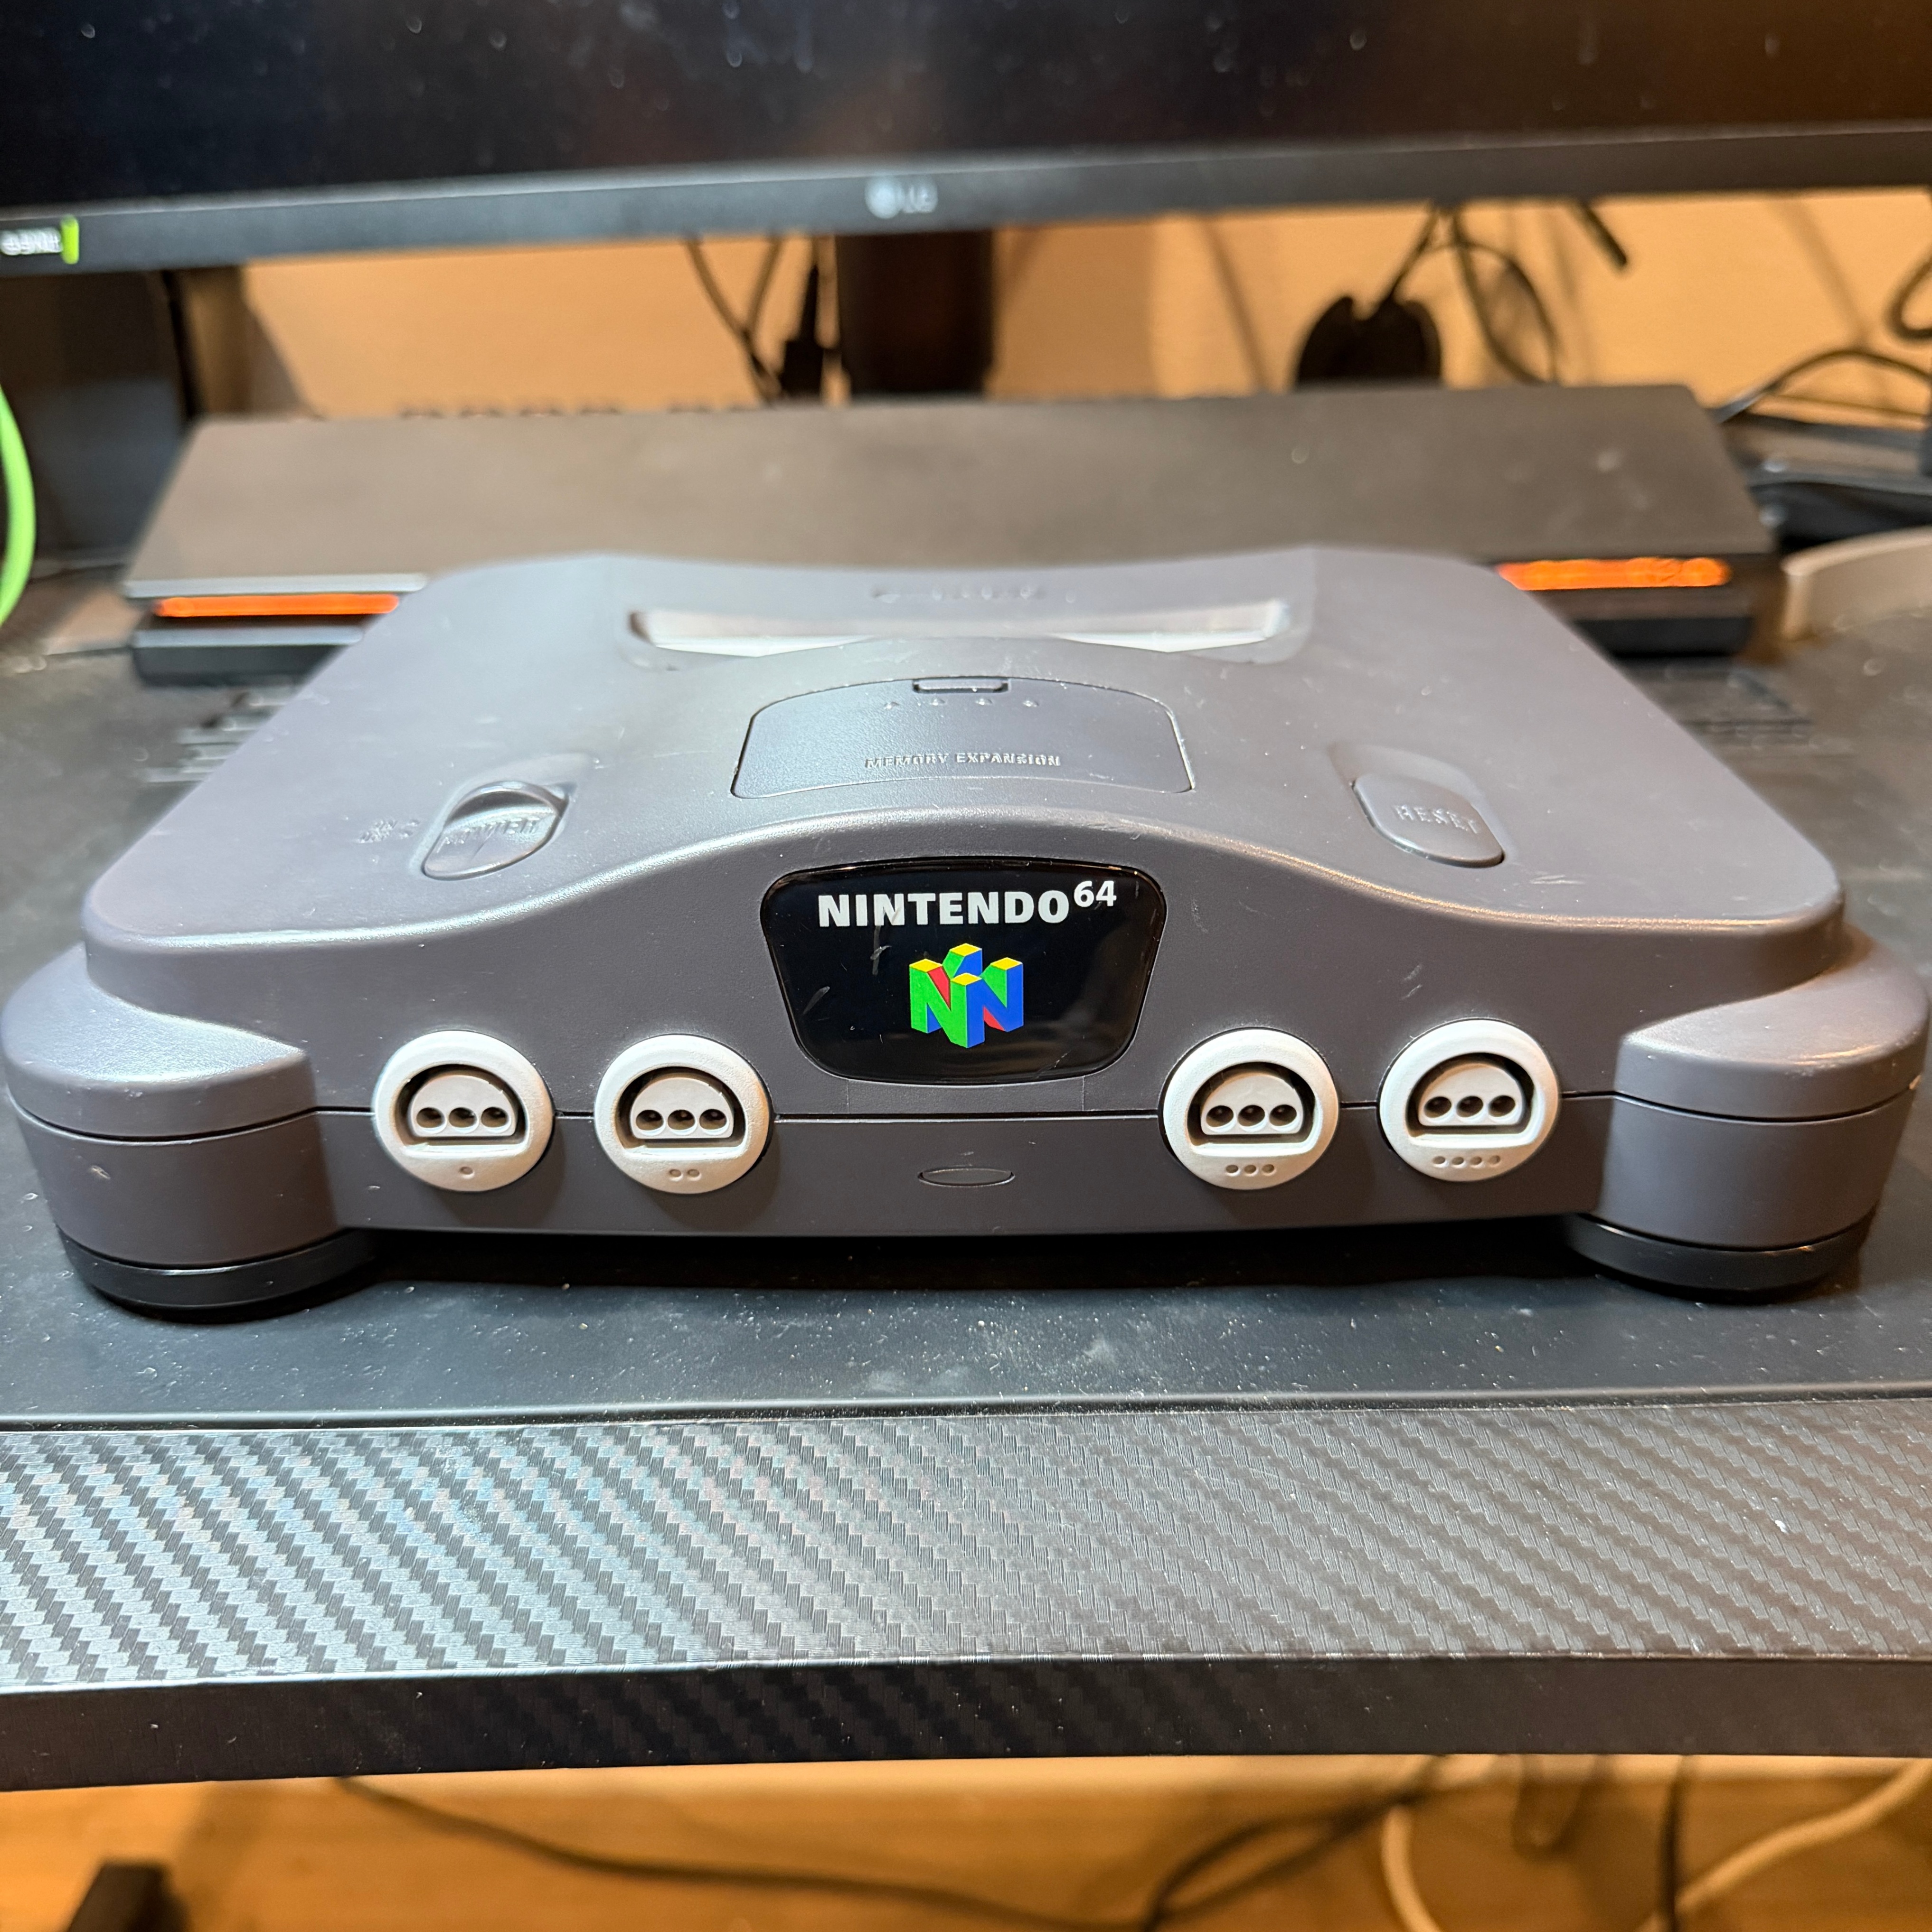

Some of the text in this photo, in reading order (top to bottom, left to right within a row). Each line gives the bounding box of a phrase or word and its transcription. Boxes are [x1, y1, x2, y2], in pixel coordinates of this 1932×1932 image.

[865, 752, 1061, 768] MEMORY EXPANSION
[1394, 805, 1478, 834] RESET
[818, 880, 1117, 927] NINTENDO 64
